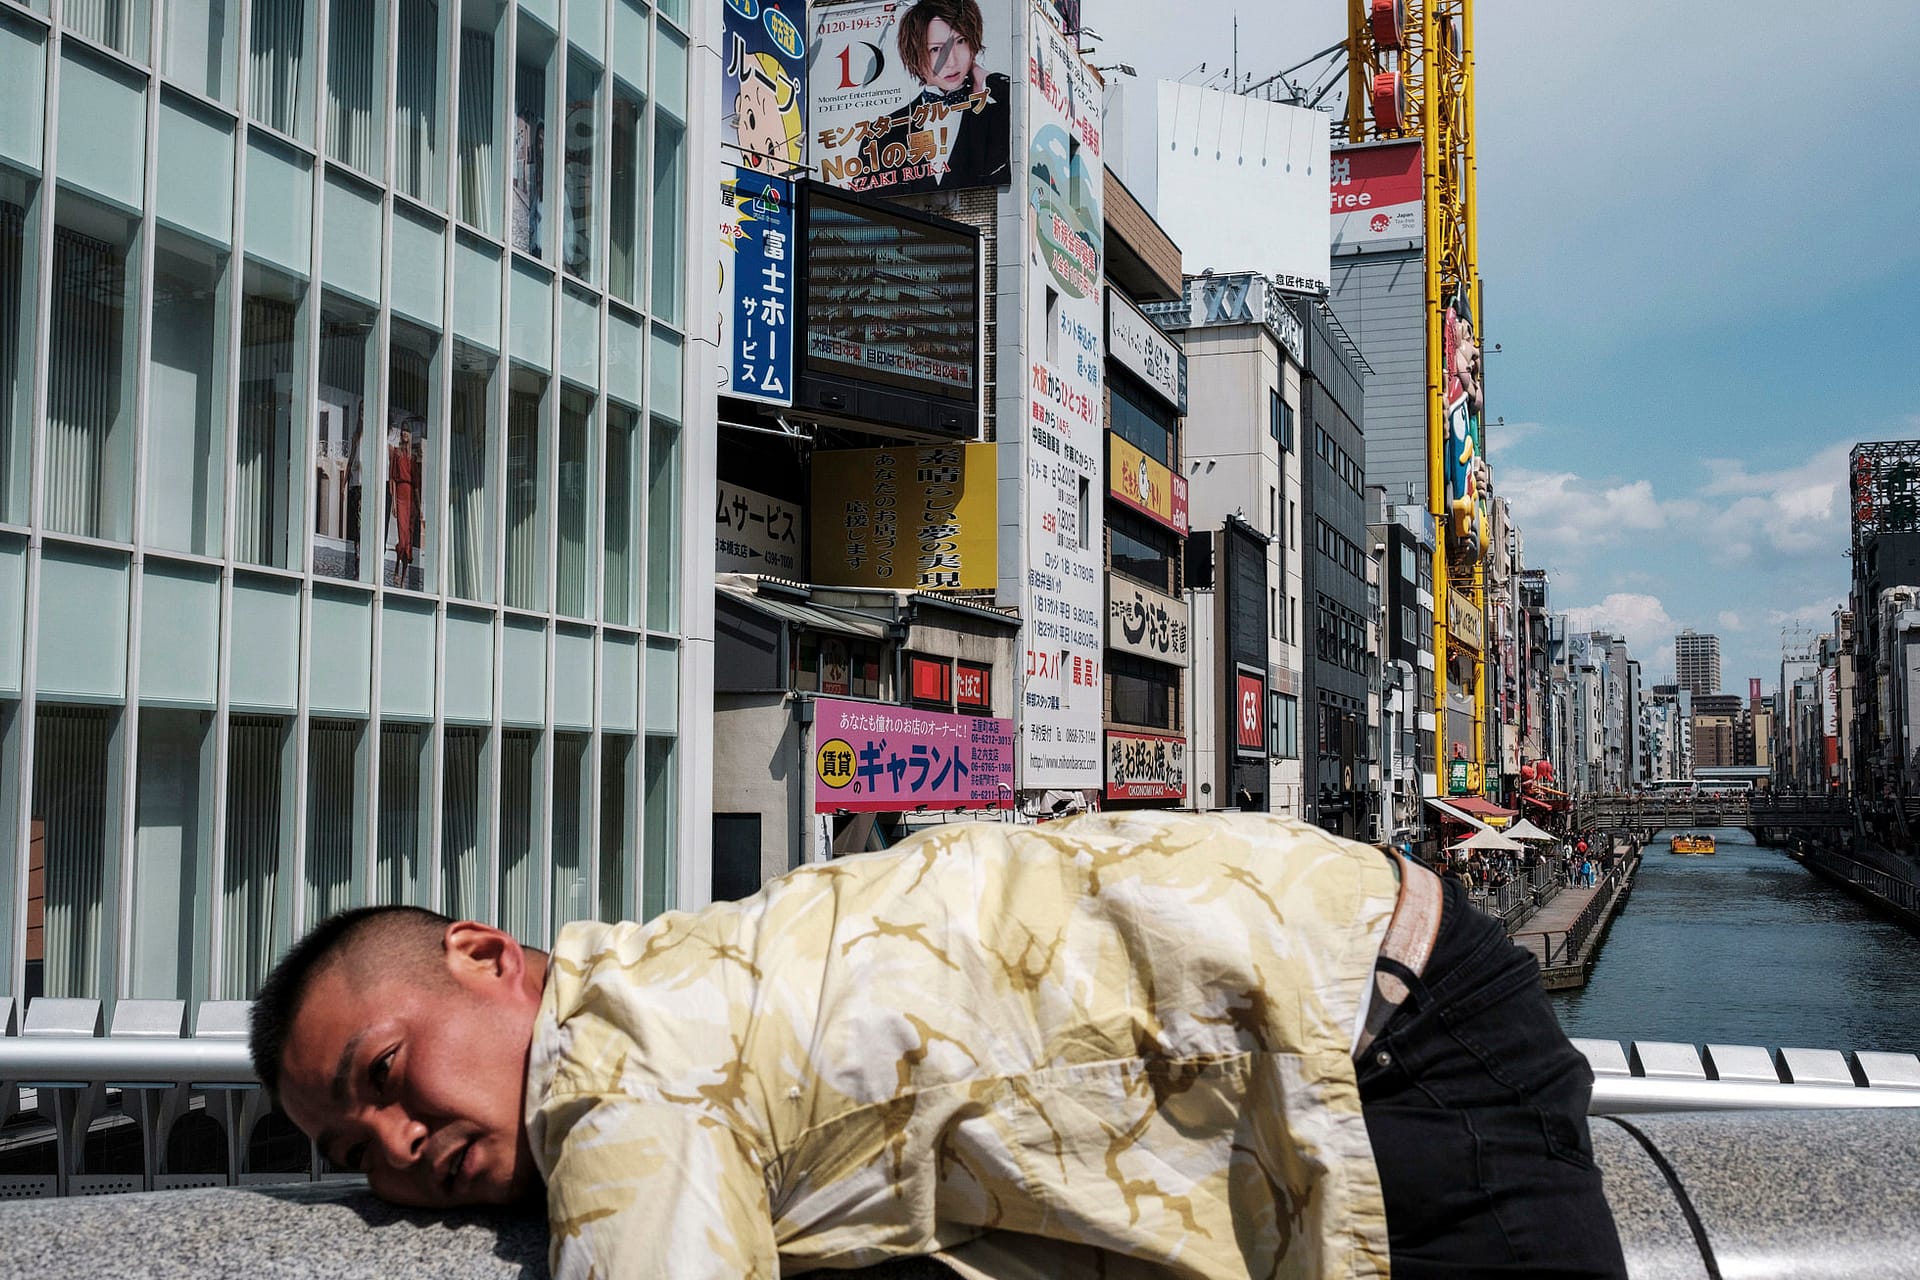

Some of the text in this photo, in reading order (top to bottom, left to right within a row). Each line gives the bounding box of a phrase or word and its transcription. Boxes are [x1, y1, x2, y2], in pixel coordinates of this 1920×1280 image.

[818, 15, 896, 35] 0120-194-373
[818, 87, 901, 104] Monster Entertainment
[818, 96, 902, 113] DEEP GROUP
[818, 88, 991, 149] モンスターグループ
[902, 161, 951, 179] RUKA
[1330, 192, 1371, 208] Free
[1276, 274, 1324, 290] 意匠作成中
[761, 229, 785, 394] 富士ホーム
[742, 296, 757, 382] サービス
[873, 453, 896, 578] あなたのお店づくり
[917, 449, 961, 588] 素晴らしい夢の実現
[845, 500, 869, 569] 応援します
[1060, 601, 1070, 619] 平日
[1123, 591, 1170, 653] うなぎ
[1060, 625, 1070, 643] 平日
[1073, 655, 1099, 687] 最高!
[957, 673, 980, 698] たばこ
[839, 712, 967, 738] あなたも憧れのお店のオーナーに!
[1030, 724, 1052, 742] 予約受付
[822, 738, 969, 794] 賃貸 の ギャラント
[1125, 739, 1165, 781] お好み焼
[1128, 785, 1164, 796] OKONOMIYAKI
